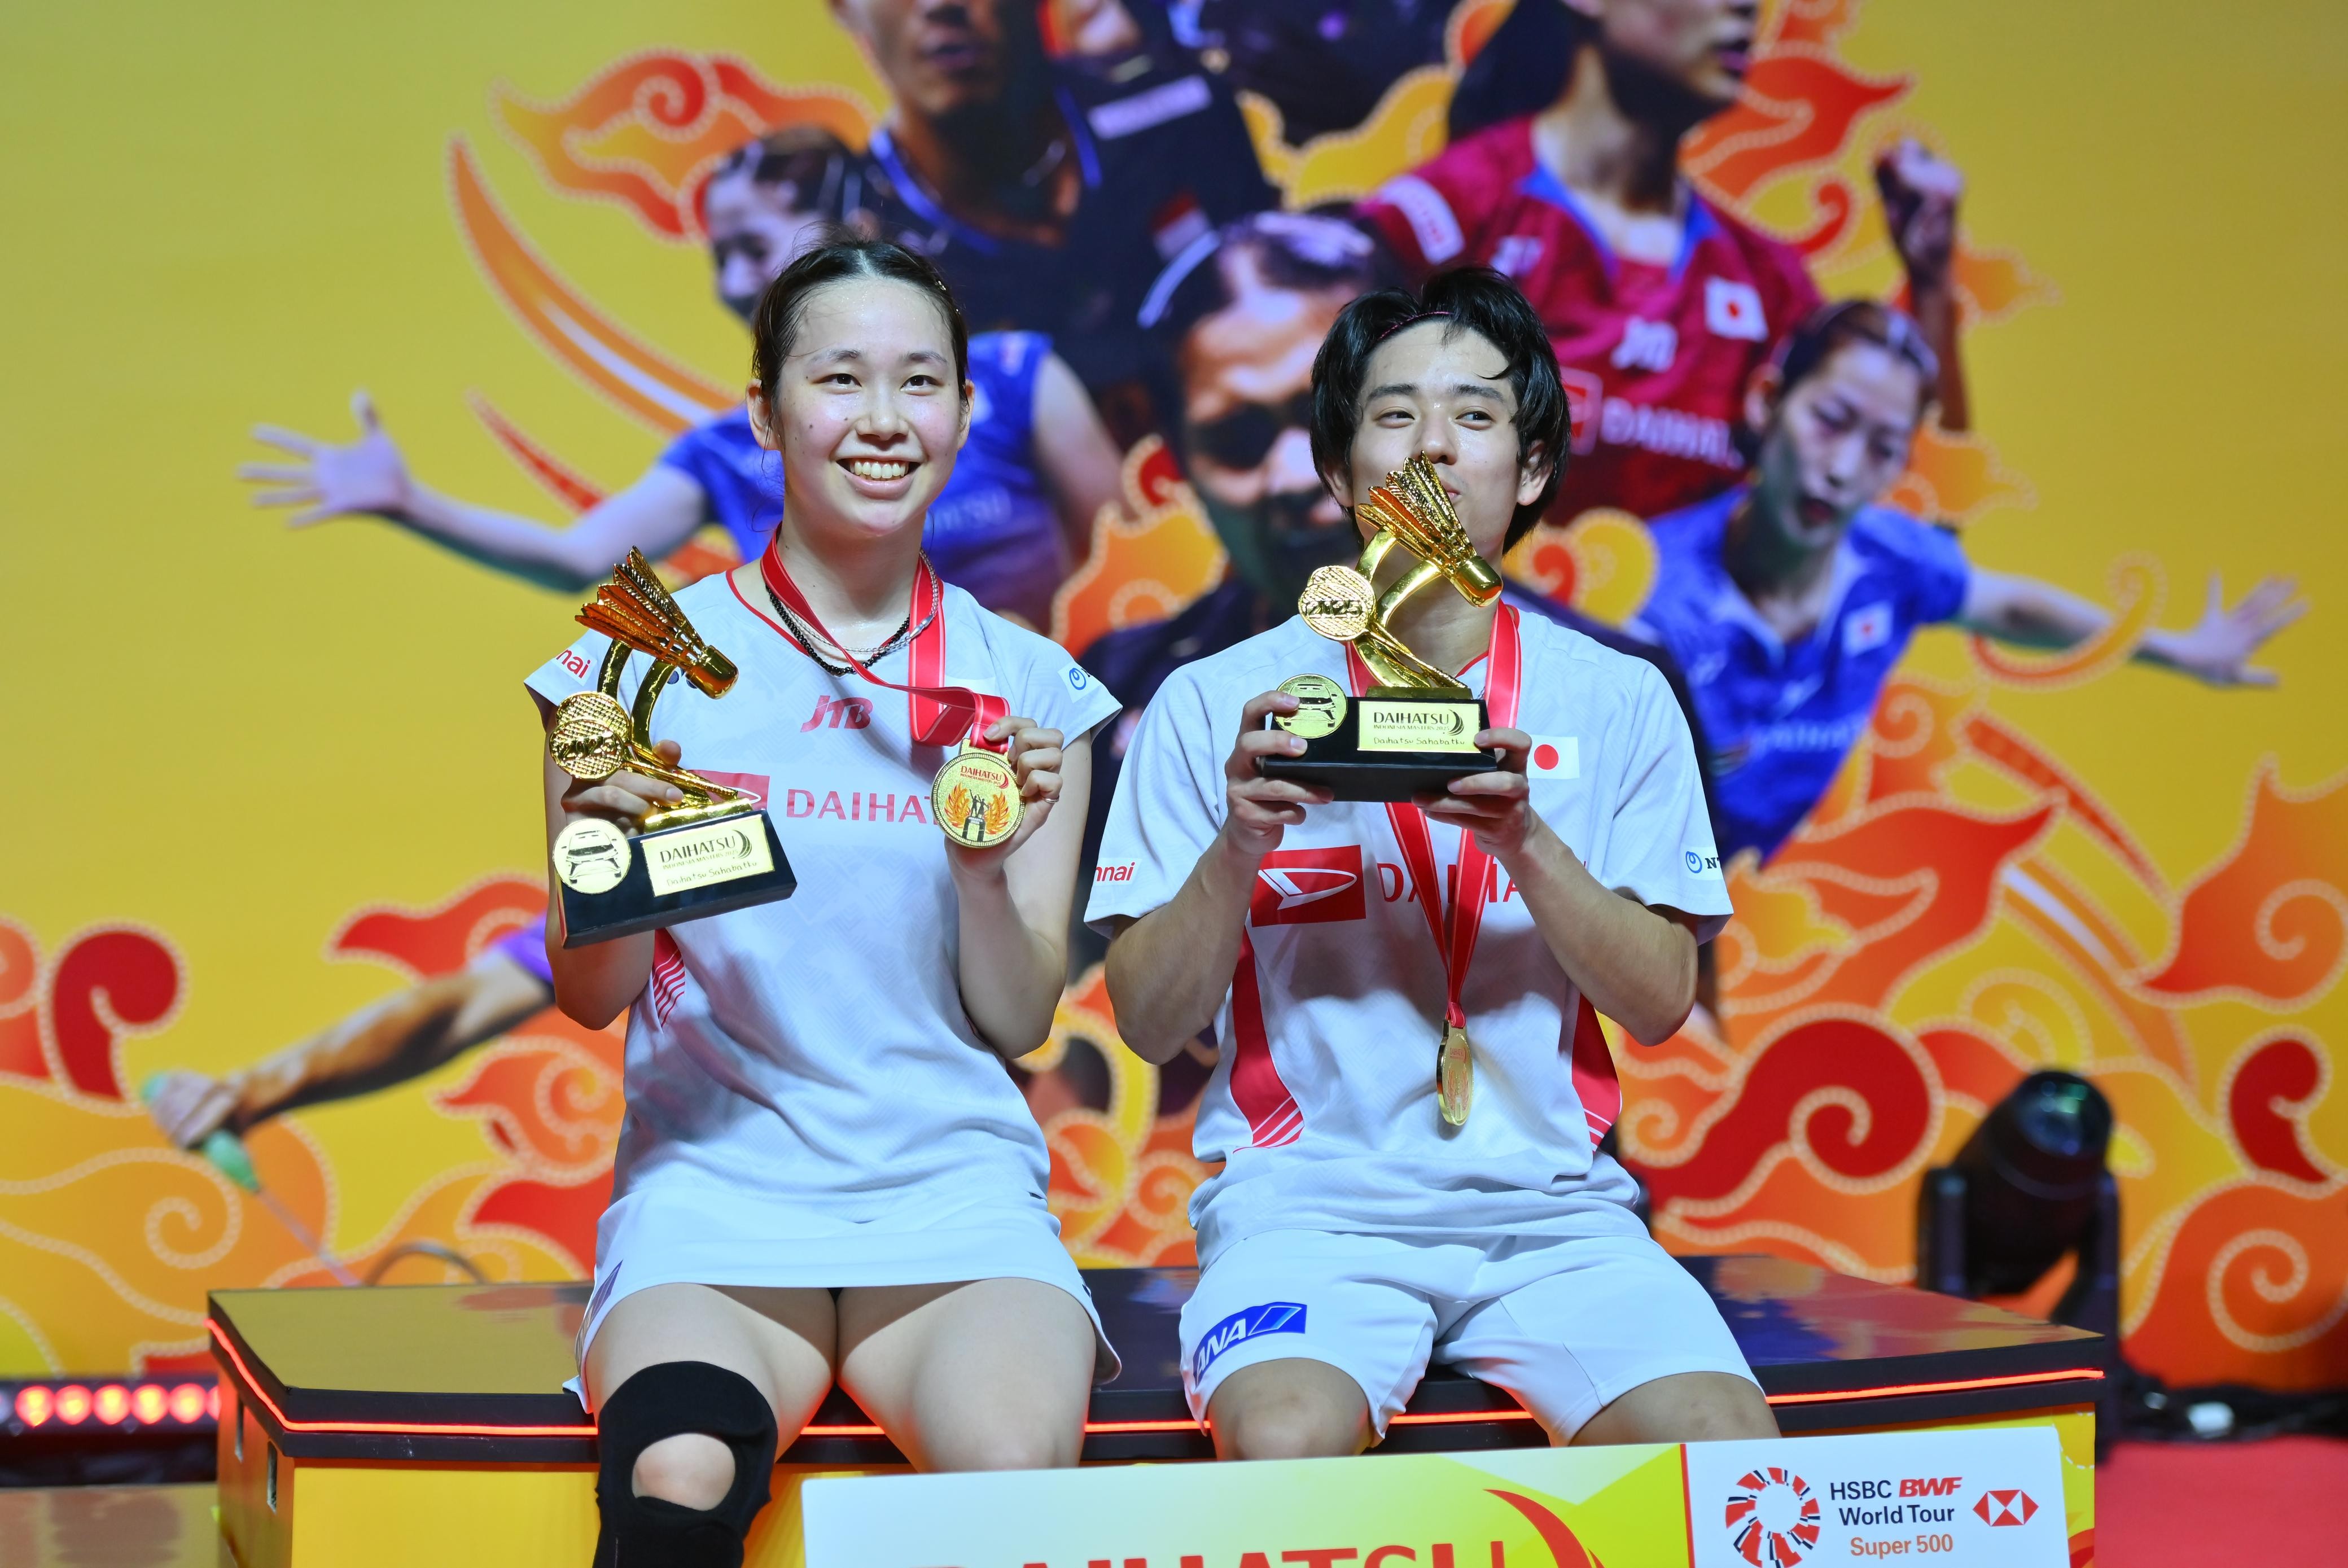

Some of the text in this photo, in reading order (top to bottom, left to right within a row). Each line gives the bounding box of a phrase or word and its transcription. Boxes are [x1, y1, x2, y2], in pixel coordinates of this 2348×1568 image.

[800, 695, 874, 733] JTB
[1374, 712, 1449, 725] DAIHATSU
[960, 765, 1002, 781] DAIHATSU
[786, 789, 938, 825] DAIHA
[660, 835, 735, 863] DAIHATSU
[663, 859, 695, 870] INDONESIA
[696, 853, 724, 862] MASTERS
[1705, 857, 1719, 869] N
[667, 873, 707, 887] Daihatsu
[1196, 1319, 1246, 1382] ANA
[1830, 1477, 1962, 1500] HSBC BWF
[1838, 1504, 1955, 1526] World Tour
[1850, 1533, 1953, 1559] Super 500
